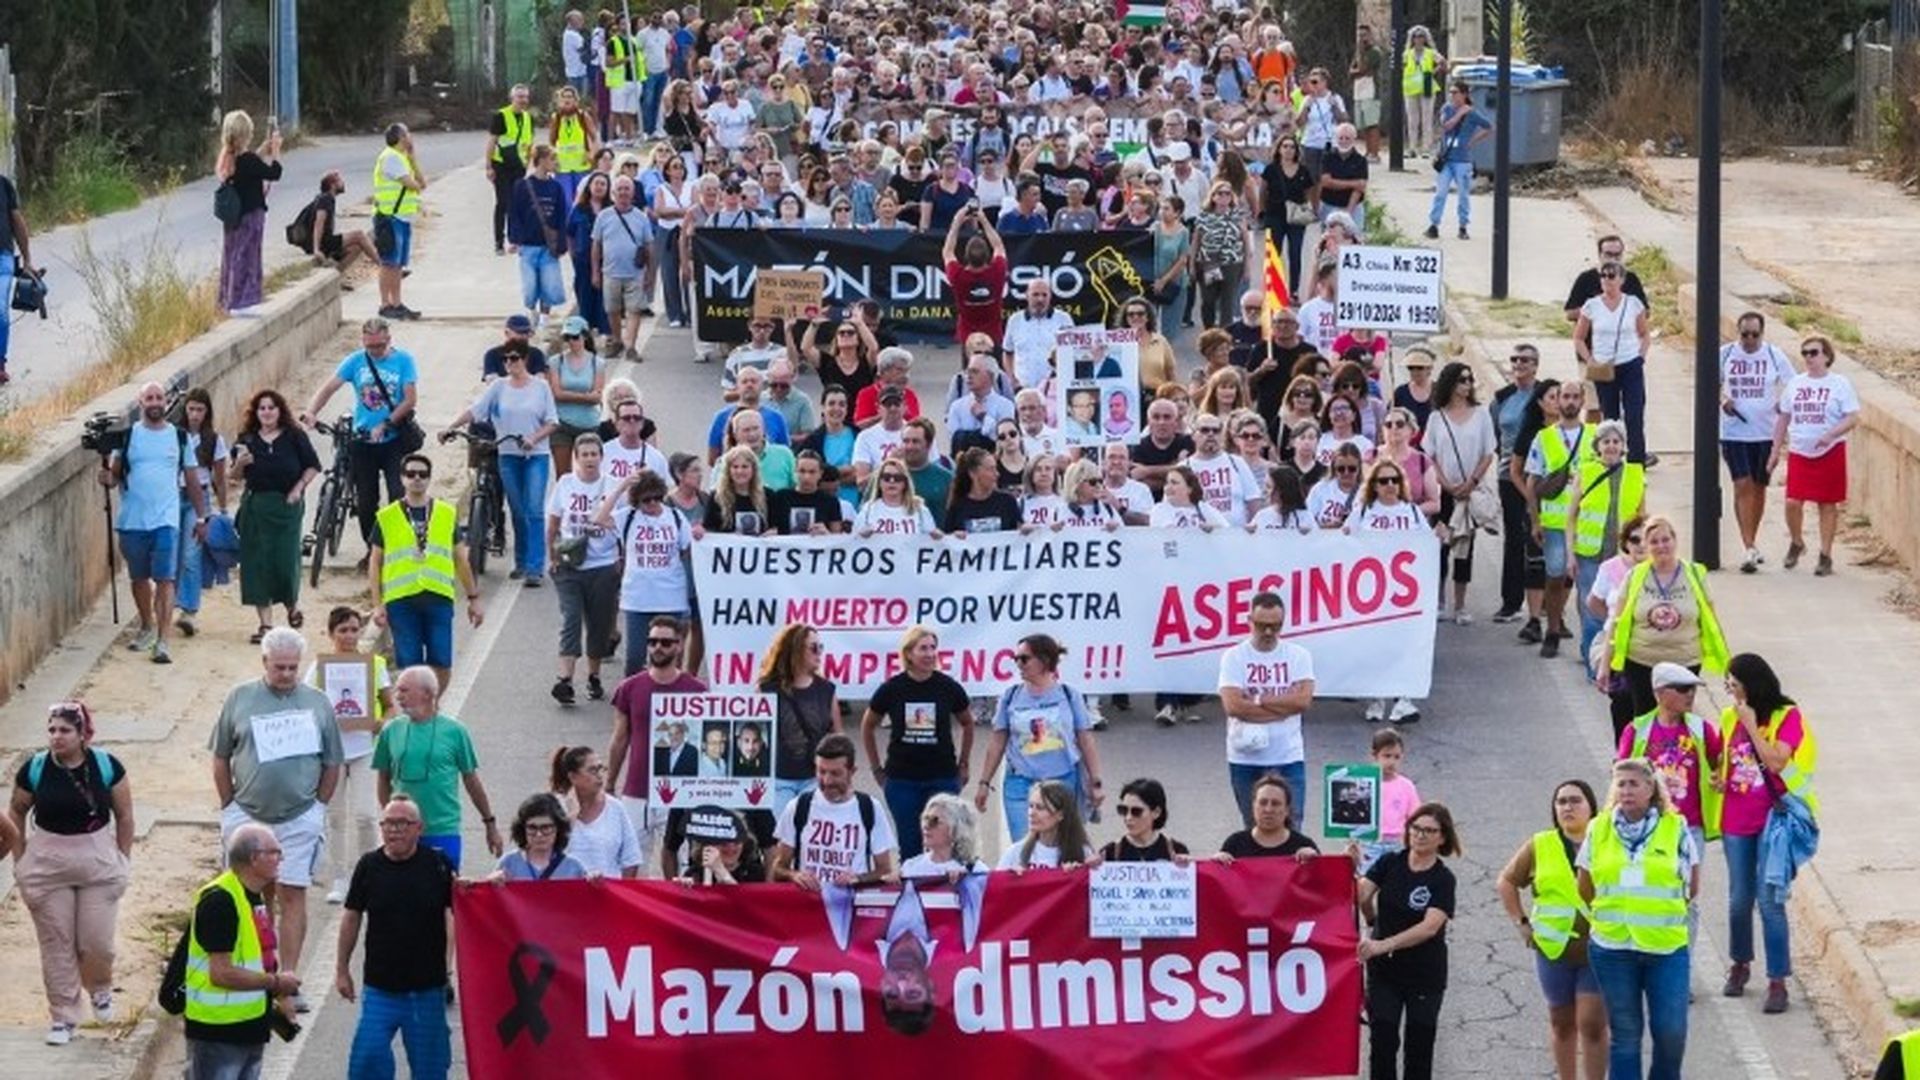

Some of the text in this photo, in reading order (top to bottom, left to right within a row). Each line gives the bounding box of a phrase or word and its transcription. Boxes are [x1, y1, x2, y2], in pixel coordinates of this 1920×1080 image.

[1414, 255, 1438, 273] 322
[908, 306, 953, 319] DANA
[711, 540, 1123, 575] NUESTROS FAMILIARES
[711, 591, 1122, 627] HAN MUERTO POR VUESTRA
[1247, 662, 1289, 683] 20:11
[655, 696, 772, 717] JUSTICIA
[809, 819, 859, 850] 20:11
[1100, 866, 1162, 882] JUSTICIA
[583, 921, 1327, 1039] Mazón dimissió
